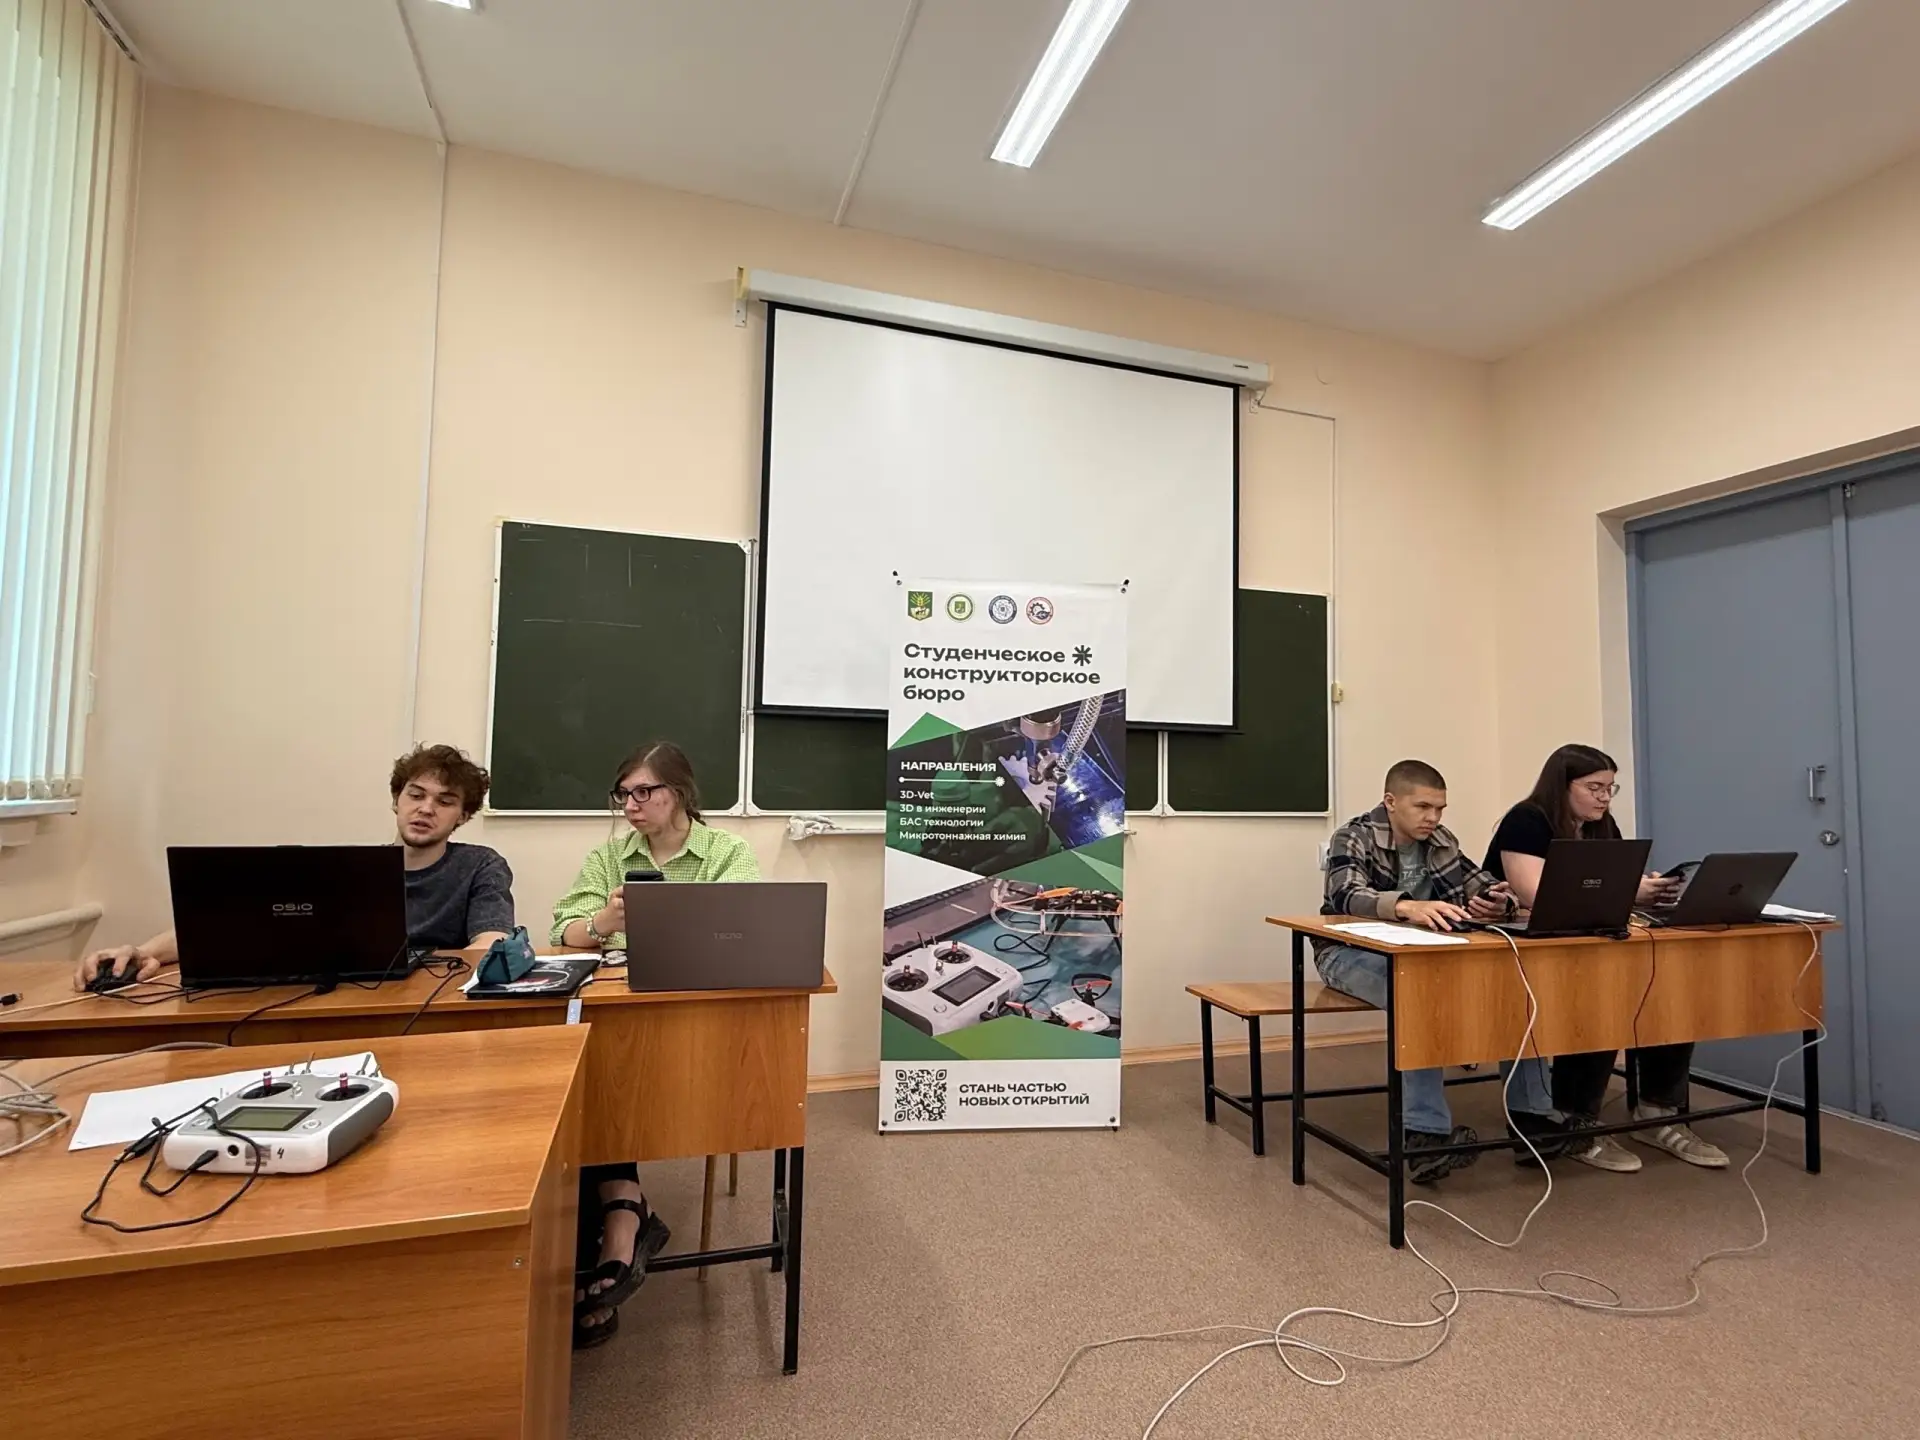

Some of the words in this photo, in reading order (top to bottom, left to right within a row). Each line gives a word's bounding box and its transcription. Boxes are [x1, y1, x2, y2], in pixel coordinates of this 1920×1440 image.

[904, 643, 1065, 662] Студенческое
[903, 667, 1101, 685] конструкторское
[903, 685, 965, 703] бюро
[900, 761, 997, 772] НАПРАВЛЕНИЯ
[900, 790, 935, 799] 3D-Vet
[899, 804, 914, 813] 3D
[916, 805, 923, 813] в
[925, 805, 986, 815] инженерии
[899, 817, 922, 826] БАС
[924, 819, 984, 828] технологии
[899, 831, 991, 841] Микротоннажная
[993, 833, 1027, 841] химия
[959, 1083, 1006, 1093] СТАНЬ
[1007, 1082, 1067, 1093] ЧАСТЬЮ
[959, 1096, 1010, 1106] НОВЫХ
[1012, 1093, 1090, 1105] ОТКРЫТИЙ
